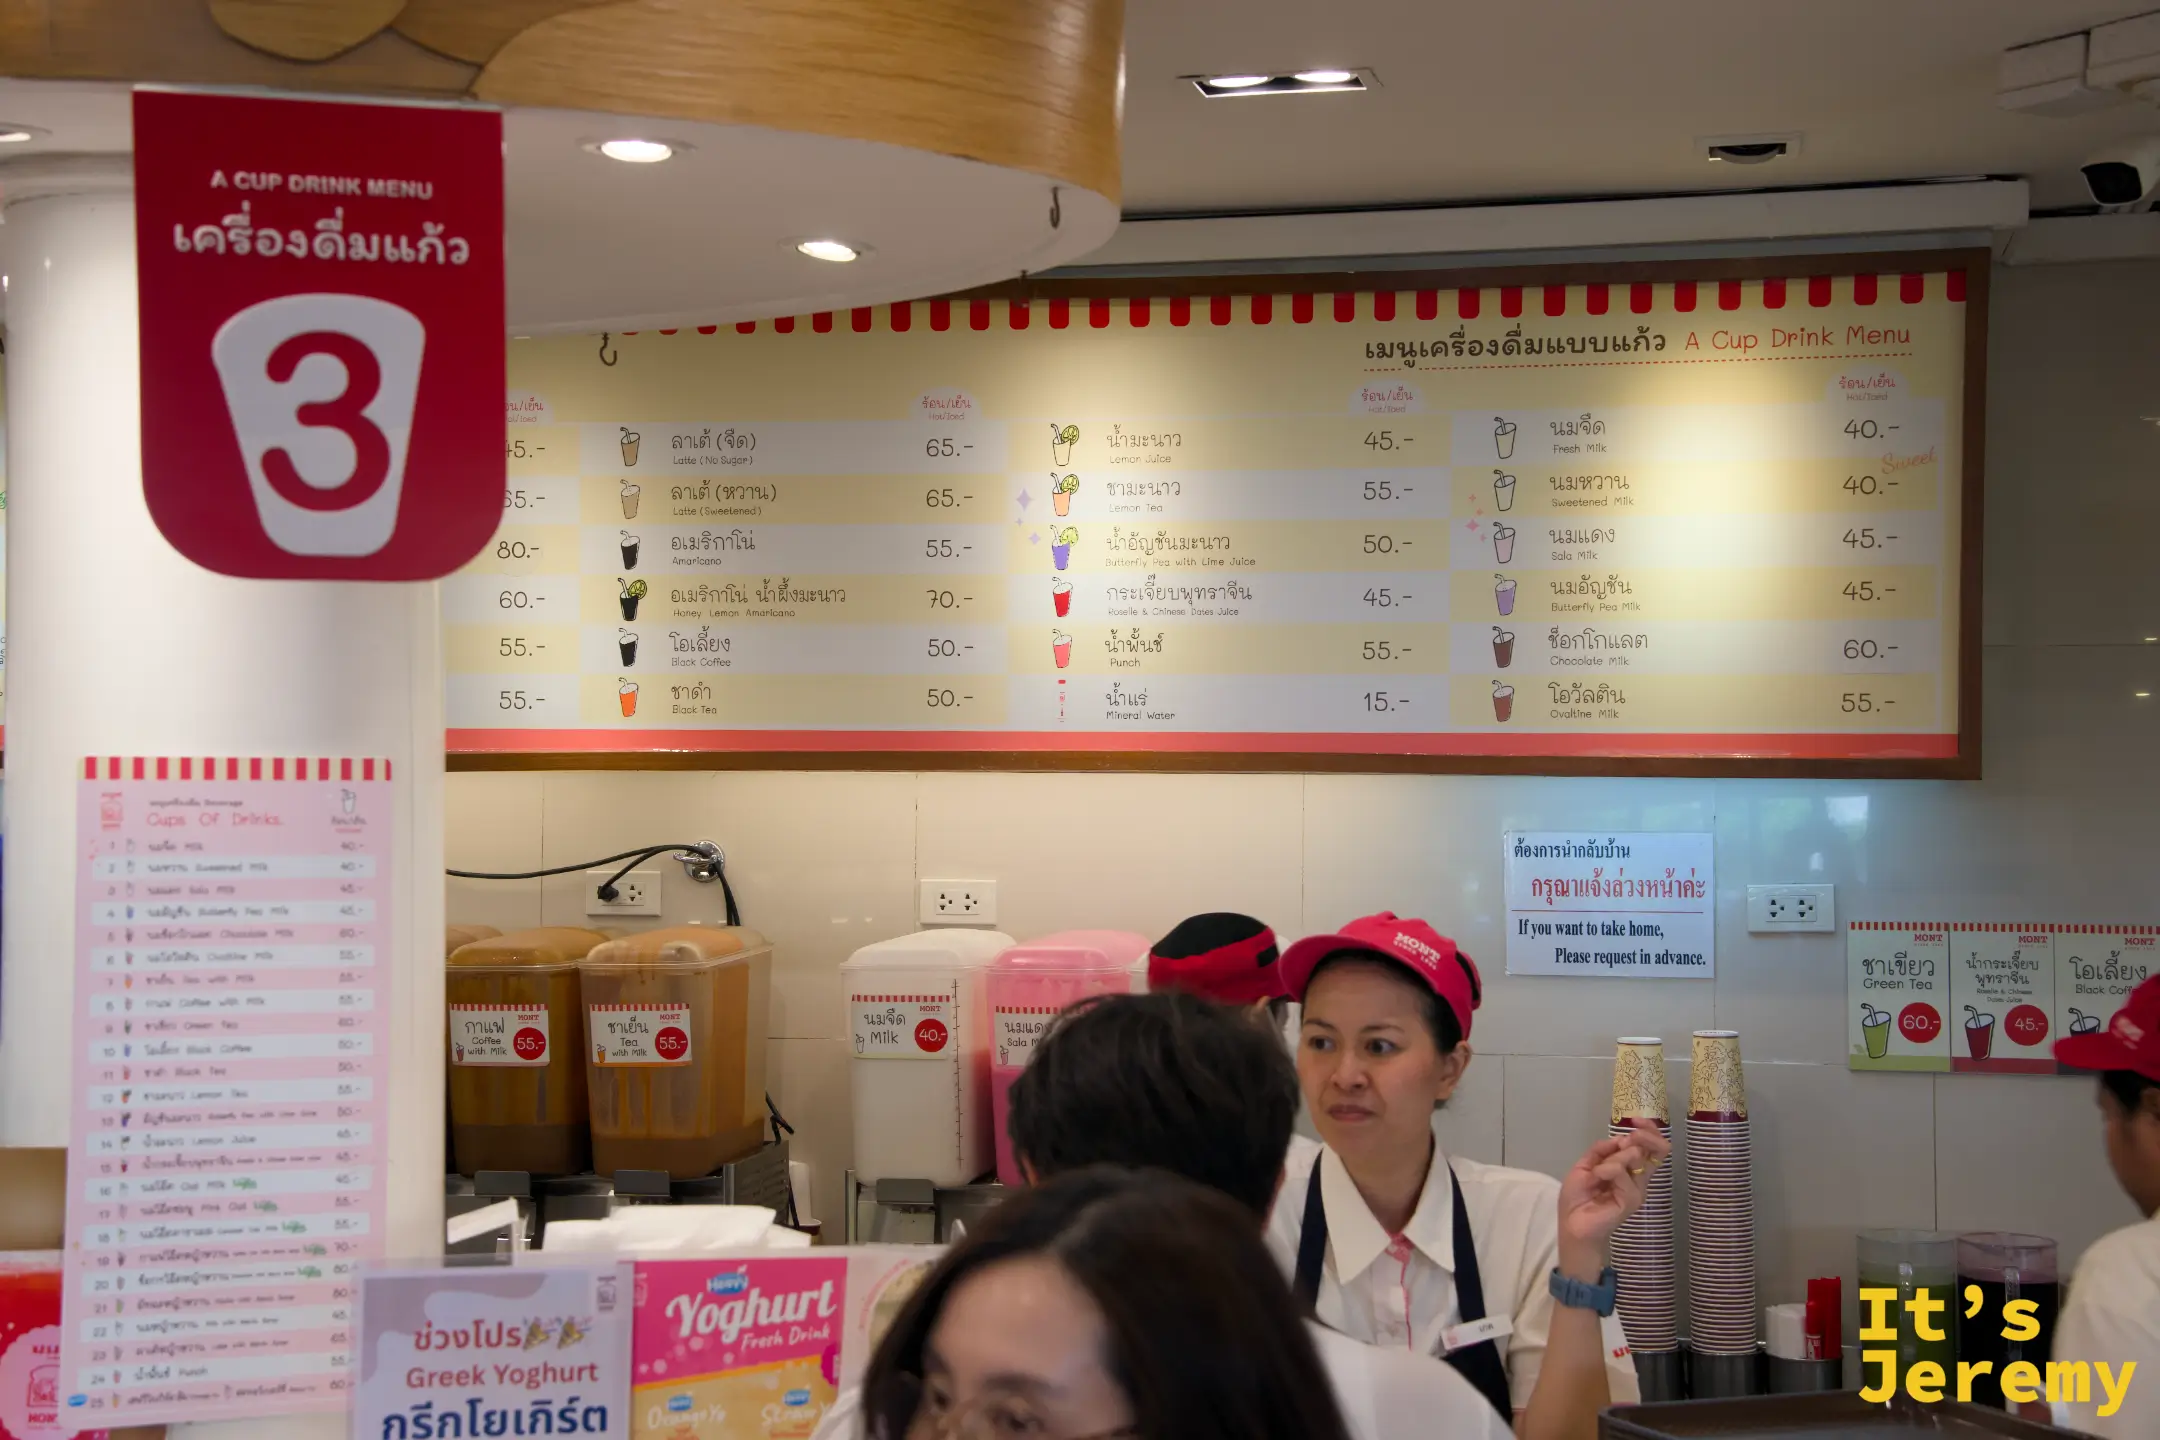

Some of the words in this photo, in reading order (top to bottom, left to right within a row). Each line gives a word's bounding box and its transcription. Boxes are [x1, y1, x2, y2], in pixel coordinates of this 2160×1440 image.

[211, 170, 227, 188] A
[234, 172, 282, 191] CUP
[288, 174, 361, 196] DRINK
[368, 180, 434, 200] MENU
[174, 200, 470, 265] เครื่องดื่มแก้ว
[1364, 322, 1666, 368] เมนูเครื่องดื่มแบบแก้ว
[1685, 333, 1700, 351] A
[1712, 332, 1758, 354] Cup
[1771, 328, 1833, 349] Drink
[1846, 325, 1911, 346] Menu
[1838, 372, 1896, 390] ร้อน/เย็น
[922, 396, 972, 408] ร้อน/เย็น
[1362, 388, 1413, 402] ร้อน/เย็น
[260, 330, 390, 512] 3
[1550, 413, 1606, 436] นมจืด
[1844, 418, 1900, 440] 40.-
[671, 428, 710, 450] ลาเต้
[716, 428, 756, 452] (จืด)
[1106, 424, 1182, 448] น้ำมะนาว
[1364, 431, 1414, 451] 45.-
[926, 438, 974, 458] 65.-
[1553, 444, 1580, 454] Fresh
[1587, 444, 1606, 453] Milk
[673, 456, 697, 465] Latte
[700, 455, 718, 466] (No
[720, 456, 754, 467] Sugar)
[1110, 454, 1142, 464] Lemon
[1145, 454, 1172, 464] Juice
[671, 480, 710, 500] ลาเต้
[716, 483, 777, 502] (หวาน)
[1106, 481, 1181, 496] ชามะนาว
[1364, 482, 1414, 500] 55.-
[1550, 476, 1630, 491] นมหวาน
[1842, 475, 1899, 496] 40.-
[926, 489, 974, 508] 65.-
[1552, 497, 1608, 508] Sweetened
[1614, 496, 1634, 506] Milk
[673, 507, 697, 516] Latte
[700, 506, 762, 518] (Sweetened)
[1109, 504, 1141, 512] Lemon
[1146, 504, 1163, 512] Tea
[672, 528, 756, 551] อเมริกาโน่
[1106, 526, 1230, 556] น้ำอัญชันมะนาว
[1364, 535, 1413, 554] 50.-
[1549, 528, 1616, 544] นมแดง
[1842, 528, 1898, 549] 45.-
[497, 541, 540, 559] 80.-
[926, 540, 972, 558] 55.-
[1552, 552, 1572, 561] Sala
[1578, 550, 1598, 560] Milk
[1106, 558, 1148, 568] Butterfly
[1152, 558, 1170, 567] Pea
[1176, 558, 1196, 566] with
[1202, 558, 1224, 566] Lime
[1230, 558, 1256, 566] Juice
[671, 584, 748, 604] อเมริกาโน่
[756, 577, 846, 604] น้ำผึ้งมะนาว
[1106, 574, 1252, 606] กระเจี๊ยบพุทราจีน
[1550, 574, 1632, 600] นมอัญชัน
[1842, 581, 1896, 601] 45.-
[500, 590, 546, 608] 60.-
[926, 590, 973, 608] 70.-
[1362, 588, 1412, 607] 45.-
[674, 609, 702, 619] Honey
[710, 609, 739, 618] Lemon
[1152, 608, 1186, 616] Chinese
[1217, 608, 1239, 616] Juice
[1552, 602, 1594, 612] Butterfly
[1600, 602, 1618, 612] Pea
[1622, 602, 1641, 611] Milk
[669, 626, 731, 652] โอเลี้ยง
[1104, 628, 1164, 653] น้ำพั้นช์
[1548, 625, 1648, 650] ช็อกโกแลต
[500, 638, 546, 656] 55.-
[928, 639, 974, 657] 50.-
[1362, 641, 1412, 660] 55.-
[1844, 639, 1899, 660] 60.-
[672, 658, 696, 667] Black
[700, 658, 731, 667] Coffee
[1110, 658, 1140, 668] Punch
[1550, 656, 1603, 666] Chocolate
[1608, 656, 1629, 666] Milk
[500, 690, 546, 710] 55.-
[671, 682, 711, 700] ชาดำ
[927, 689, 973, 707] 50.-
[1106, 682, 1148, 706] น้ำแร่
[1548, 682, 1626, 704] โอวัลติน
[672, 704, 698, 714] Black
[700, 705, 717, 714] Tea
[1364, 692, 1410, 712] 15.-
[1842, 693, 1896, 714] 55.-
[1106, 711, 1142, 720] Mineral
[1146, 712, 1176, 720] Water
[1550, 709, 1592, 719] Ovaltine
[1598, 709, 1619, 719] Milk
[146, 812, 186, 828] Cups
[1514, 838, 1631, 859] ต้องการนำกลับบ้าน
[1531, 868, 1706, 906] กรุณาแจ้งล่วงหน้าค่ะ
[1518, 919, 1529, 936] If
[1530, 924, 1552, 940] you
[1555, 920, 1584, 936] want
[1586, 922, 1598, 936] to
[1601, 920, 1626, 936] take
[1628, 920, 1664, 940] home,
[1914, 934, 1943, 942] MONT
[1394, 932, 1441, 964] MONT
[2018, 936, 2048, 944] MONT
[2124, 938, 2156, 946] MONT
[1554, 948, 1591, 964] Please
[1594, 951, 1637, 968] request
[1640, 948, 1651, 965] in
[1654, 948, 1706, 966] advance.
[1862, 951, 1935, 976] ชาเขียว
[1966, 950, 2039, 970] น้ำกระเจี๊ยบ
[2068, 950, 2147, 980] โอเลี้ยง
[1863, 978, 1904, 990] Green
[1909, 978, 1933, 990] Tea
[1975, 971, 2030, 988] พุทราจีน
[2076, 984, 2104, 994] Black
[464, 1018, 505, 1034] กาแฟ
[608, 1016, 649, 1034] ชาเย็น
[864, 1008, 906, 1026] นมจืด
[1904, 1014, 1940, 1030] 60.-
[2014, 1017, 2045, 1032] 45.-
[472, 1036, 502, 1045] Coffee
[516, 1037, 546, 1050] 55.-
[620, 1038, 638, 1047] Tea
[658, 1037, 687, 1050] 55.-
[870, 1032, 899, 1044] Milk
[918, 1028, 946, 1042] 40.-
[1007, 1037, 1027, 1047] Sala
[468, 1048, 486, 1056] with
[490, 1047, 508, 1056] Milk
[612, 1048, 629, 1057] with
[632, 1048, 648, 1057] Milk
[665, 1280, 838, 1344] Yoghurt
[414, 1320, 522, 1352] ช่วงโปร
[741, 1330, 784, 1353] Fresh
[788, 1324, 830, 1346] Drink
[406, 1364, 486, 1388] Greek
[493, 1363, 599, 1390] Yoghurt
[382, 1396, 608, 1440] กรีกโยเกิร์ต
